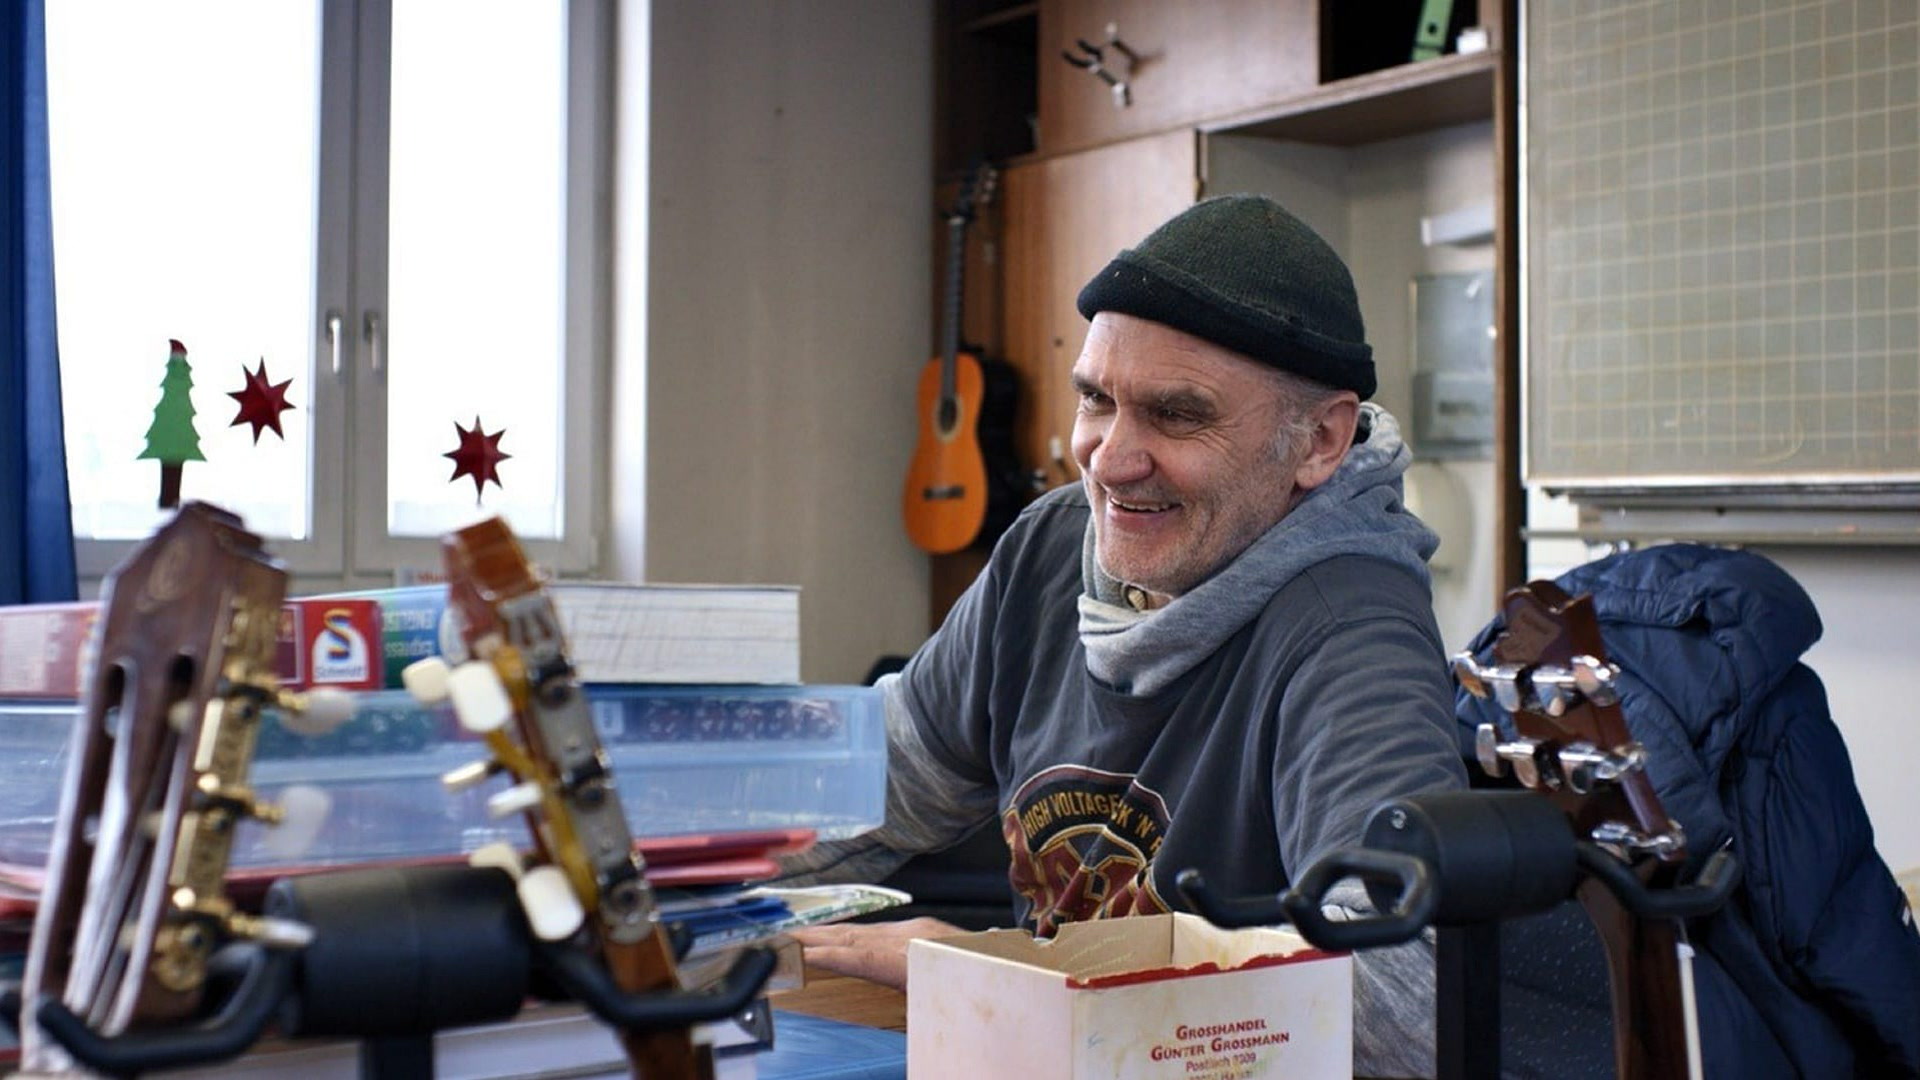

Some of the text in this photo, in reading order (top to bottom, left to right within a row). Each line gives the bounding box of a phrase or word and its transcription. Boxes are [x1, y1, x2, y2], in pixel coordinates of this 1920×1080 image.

[1023, 799, 1051, 839] HIGH
[1176, 1018, 1267, 1041] GROSSHANDEL
[1211, 1032, 1290, 1053] GROSSMANN
